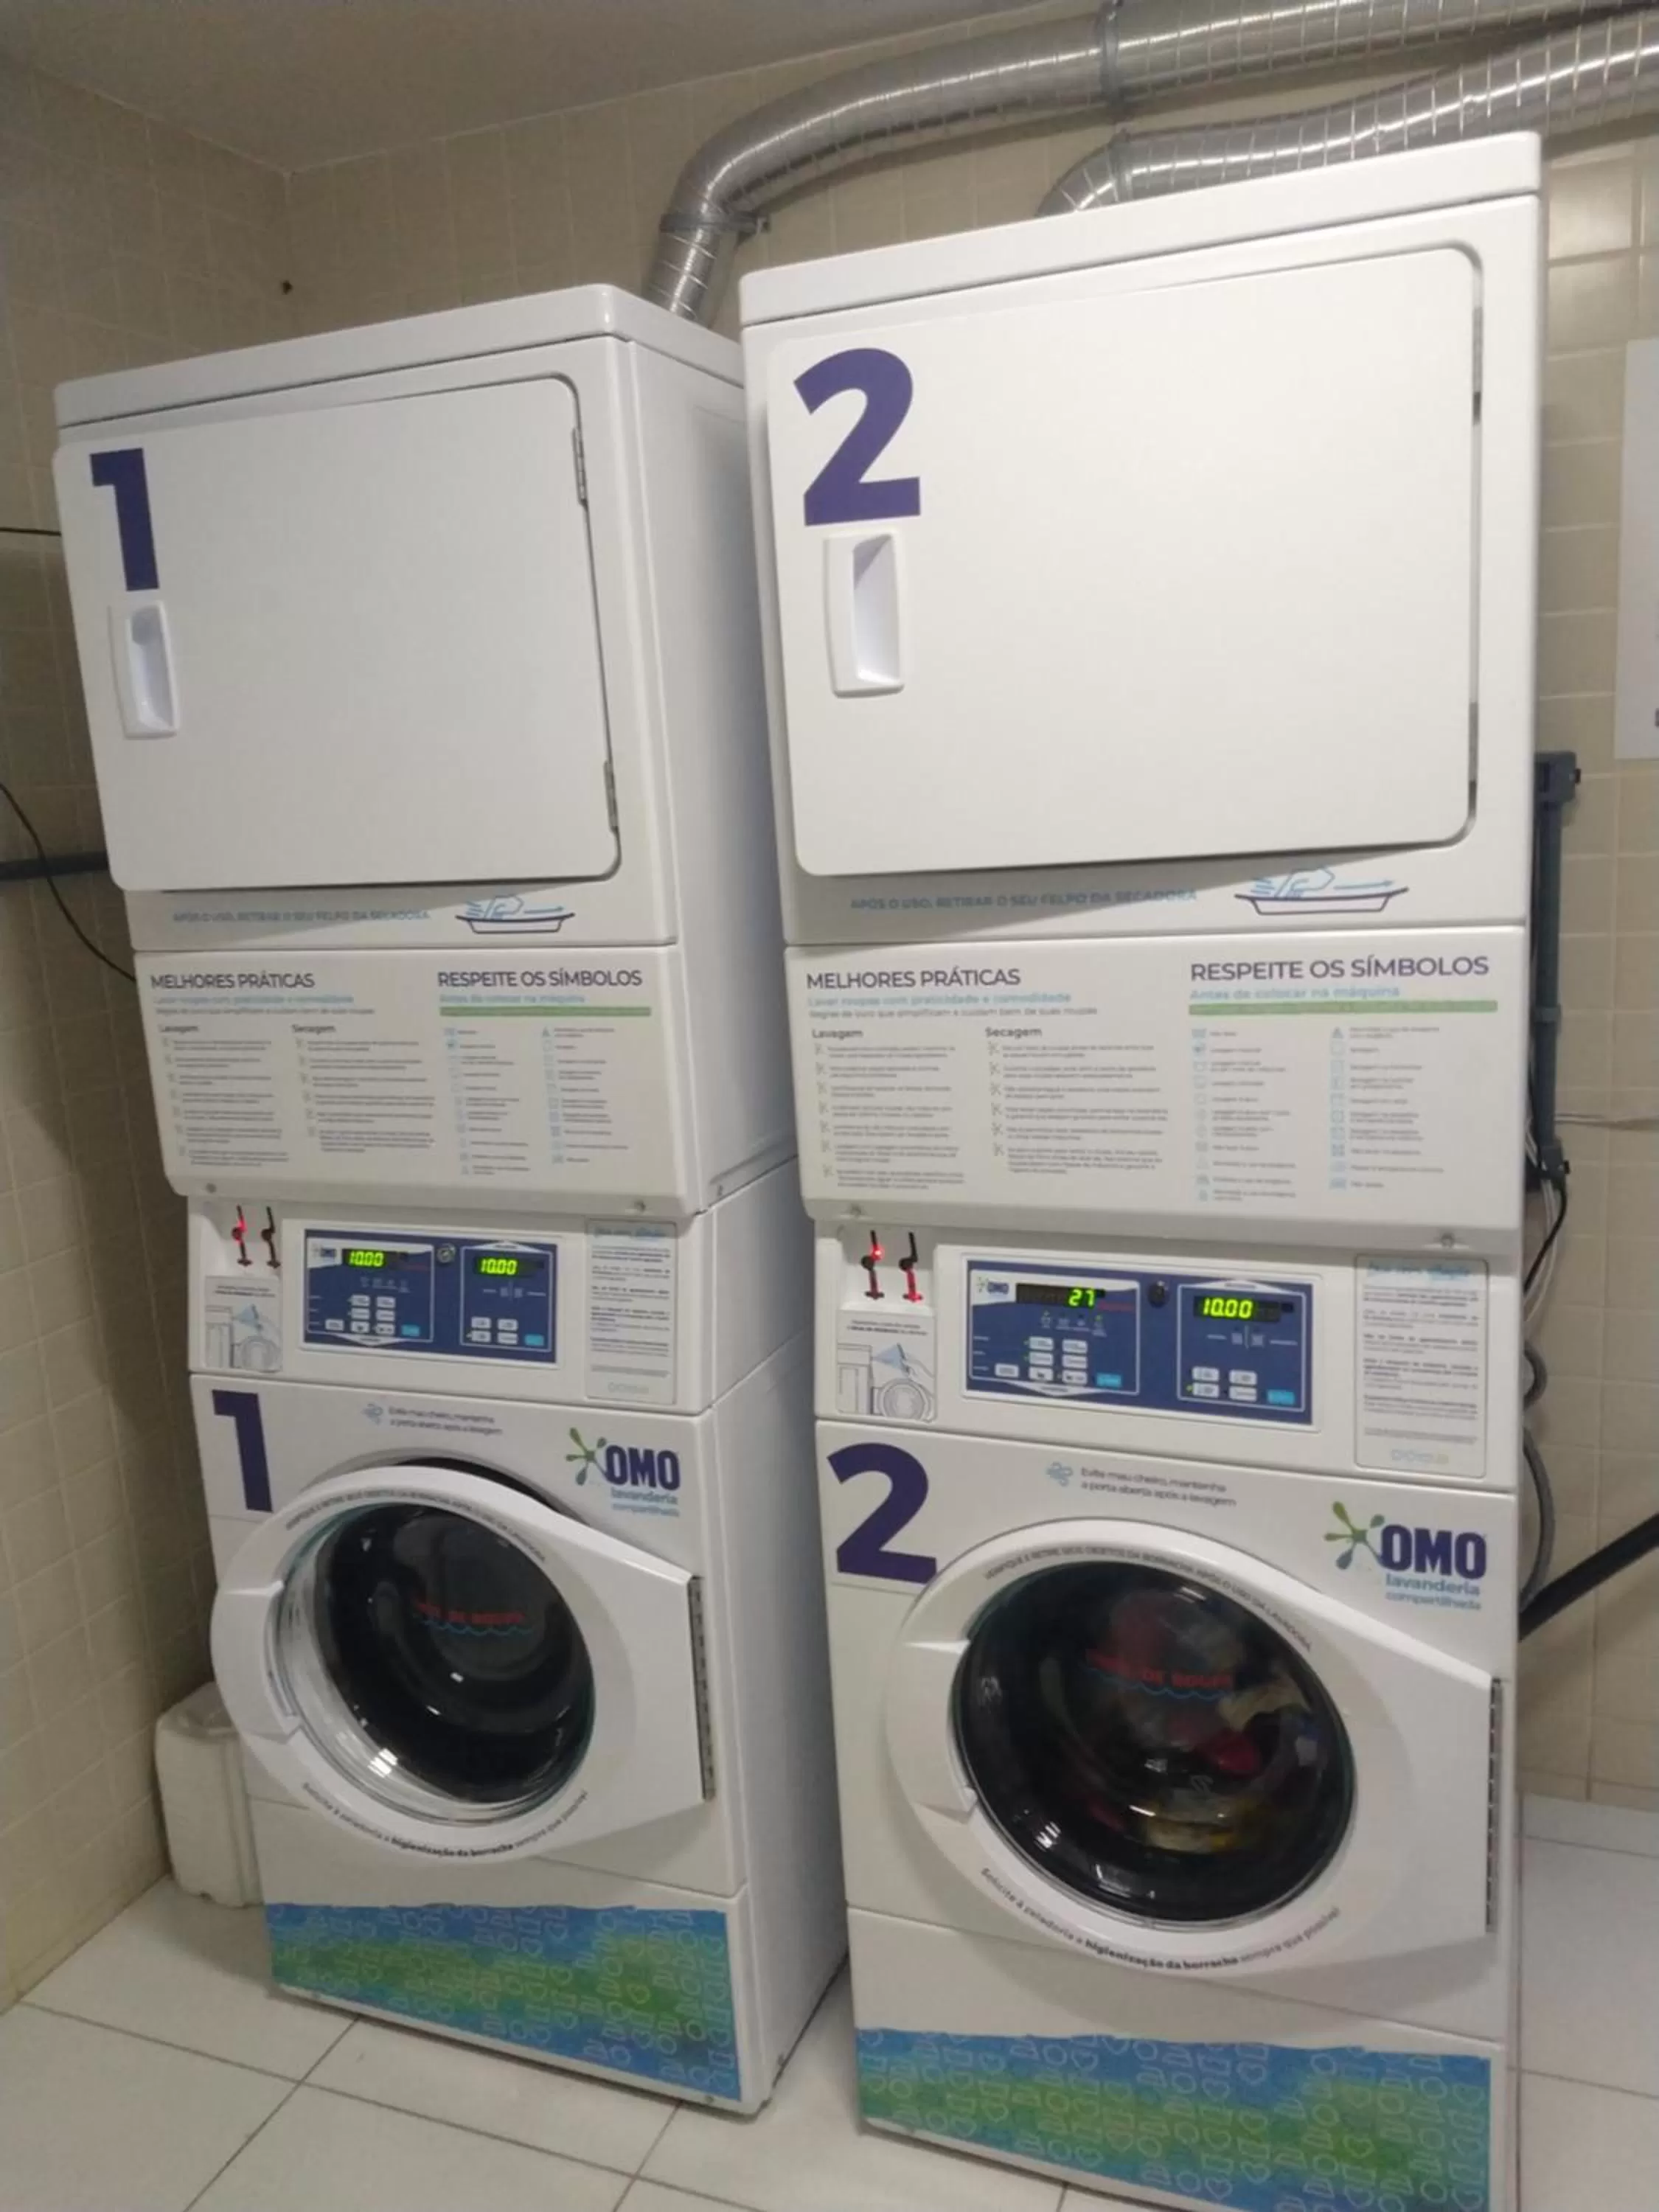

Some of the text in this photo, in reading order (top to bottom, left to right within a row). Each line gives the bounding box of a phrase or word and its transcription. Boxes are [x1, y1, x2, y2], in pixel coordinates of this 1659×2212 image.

[793, 348, 921, 526] 2
[89, 448, 159, 591] 1
[150, 970, 316, 990] MELHORES PRÁTICAS
[438, 967, 644, 987] RESPEITE OS SÍMBOLOS
[807, 967, 1021, 990] MELHORES PRÁTICAS
[1190, 955, 1489, 981] RESPEITE OS SÍMBOLOS
[811, 1029, 863, 1040] Lavagem
[985, 1026, 1043, 1040] Secagem
[1068, 1288, 1096, 1307] 27
[212, 1389, 274, 1513] 1
[605, 1444, 681, 1491] OMO
[827, 1442, 937, 1585] 2
[1381, 1523, 1487, 1580] OMO
[1385, 1573, 1481, 1596] lavanderia
[1085, 1937, 1164, 1969] higienização
[1166, 1960, 1181, 1969] da
[1182, 1956, 1239, 1969] borracha
